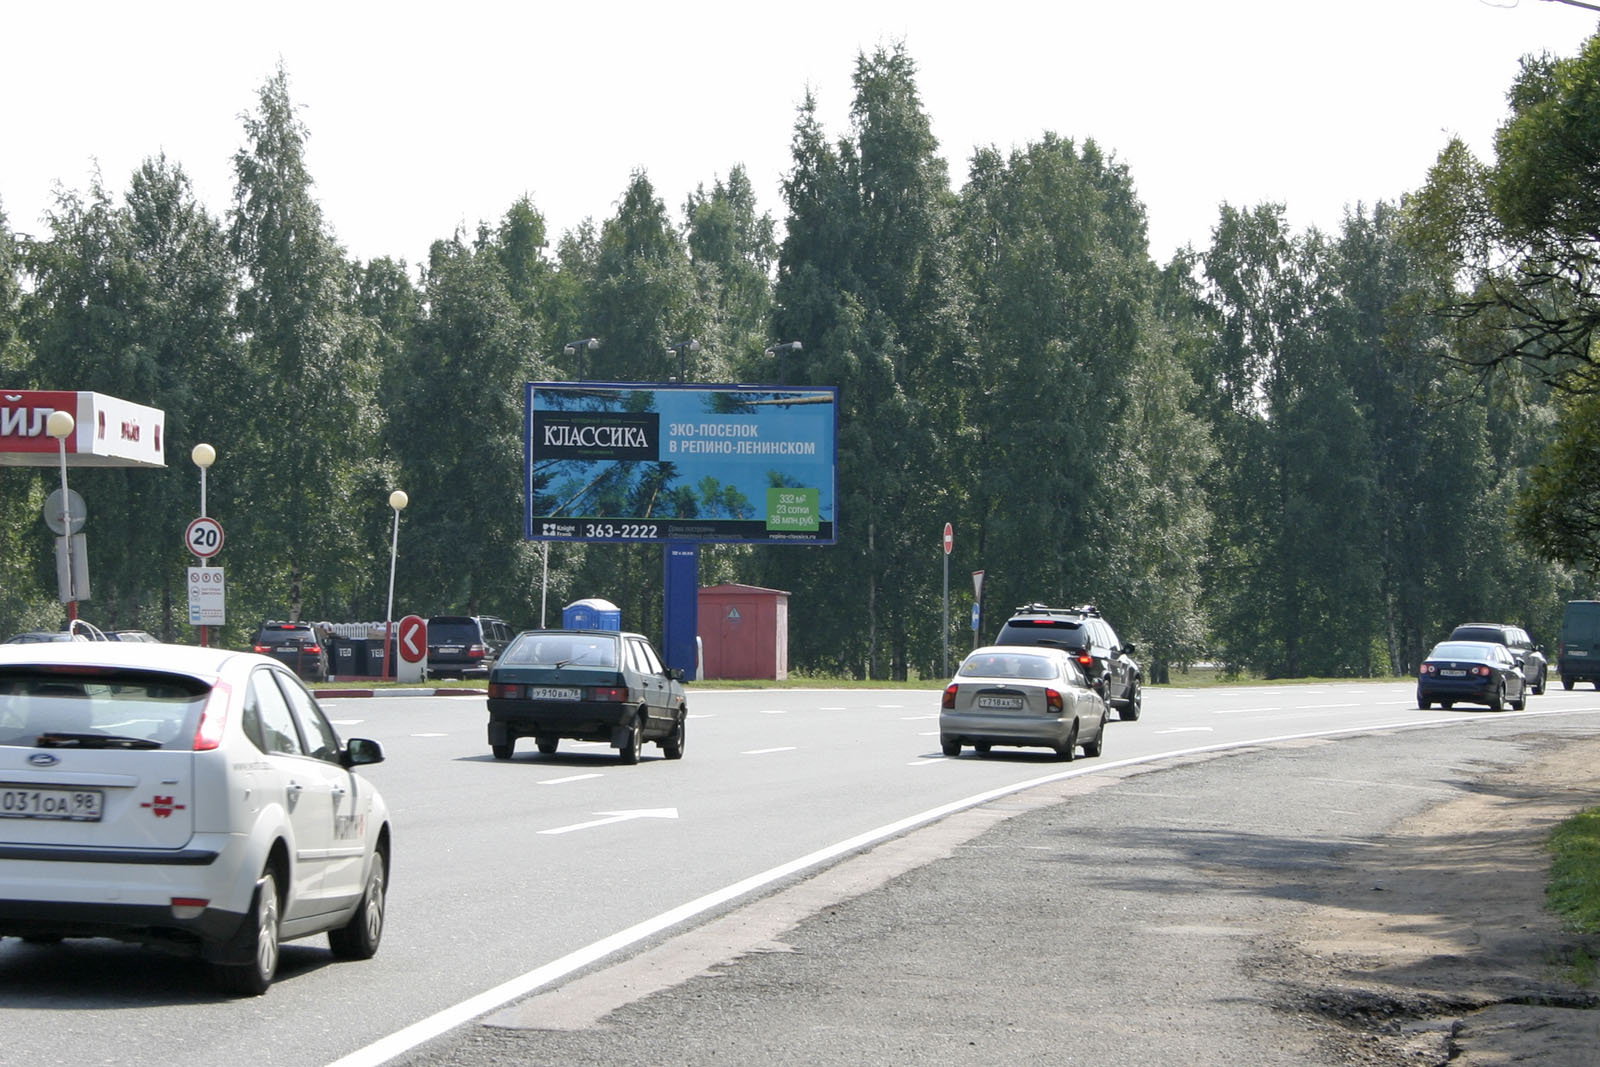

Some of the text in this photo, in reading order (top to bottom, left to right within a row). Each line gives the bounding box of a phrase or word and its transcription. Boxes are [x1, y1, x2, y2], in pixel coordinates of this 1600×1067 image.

[544, 425, 648, 447] КЛАССИКА
[669, 423, 758, 437] ЭКО-ПОСЕЛОК
[669, 440, 815, 455] В РЕПИНО-ЛЕНИНСКОМ
[780, 494, 794, 504] 332
[777, 504, 786, 514] 23
[771, 515, 780, 525] 38
[193, 527, 217, 547] 20
[586, 524, 658, 539] 363-2222
[75, 794, 94, 809] 98
